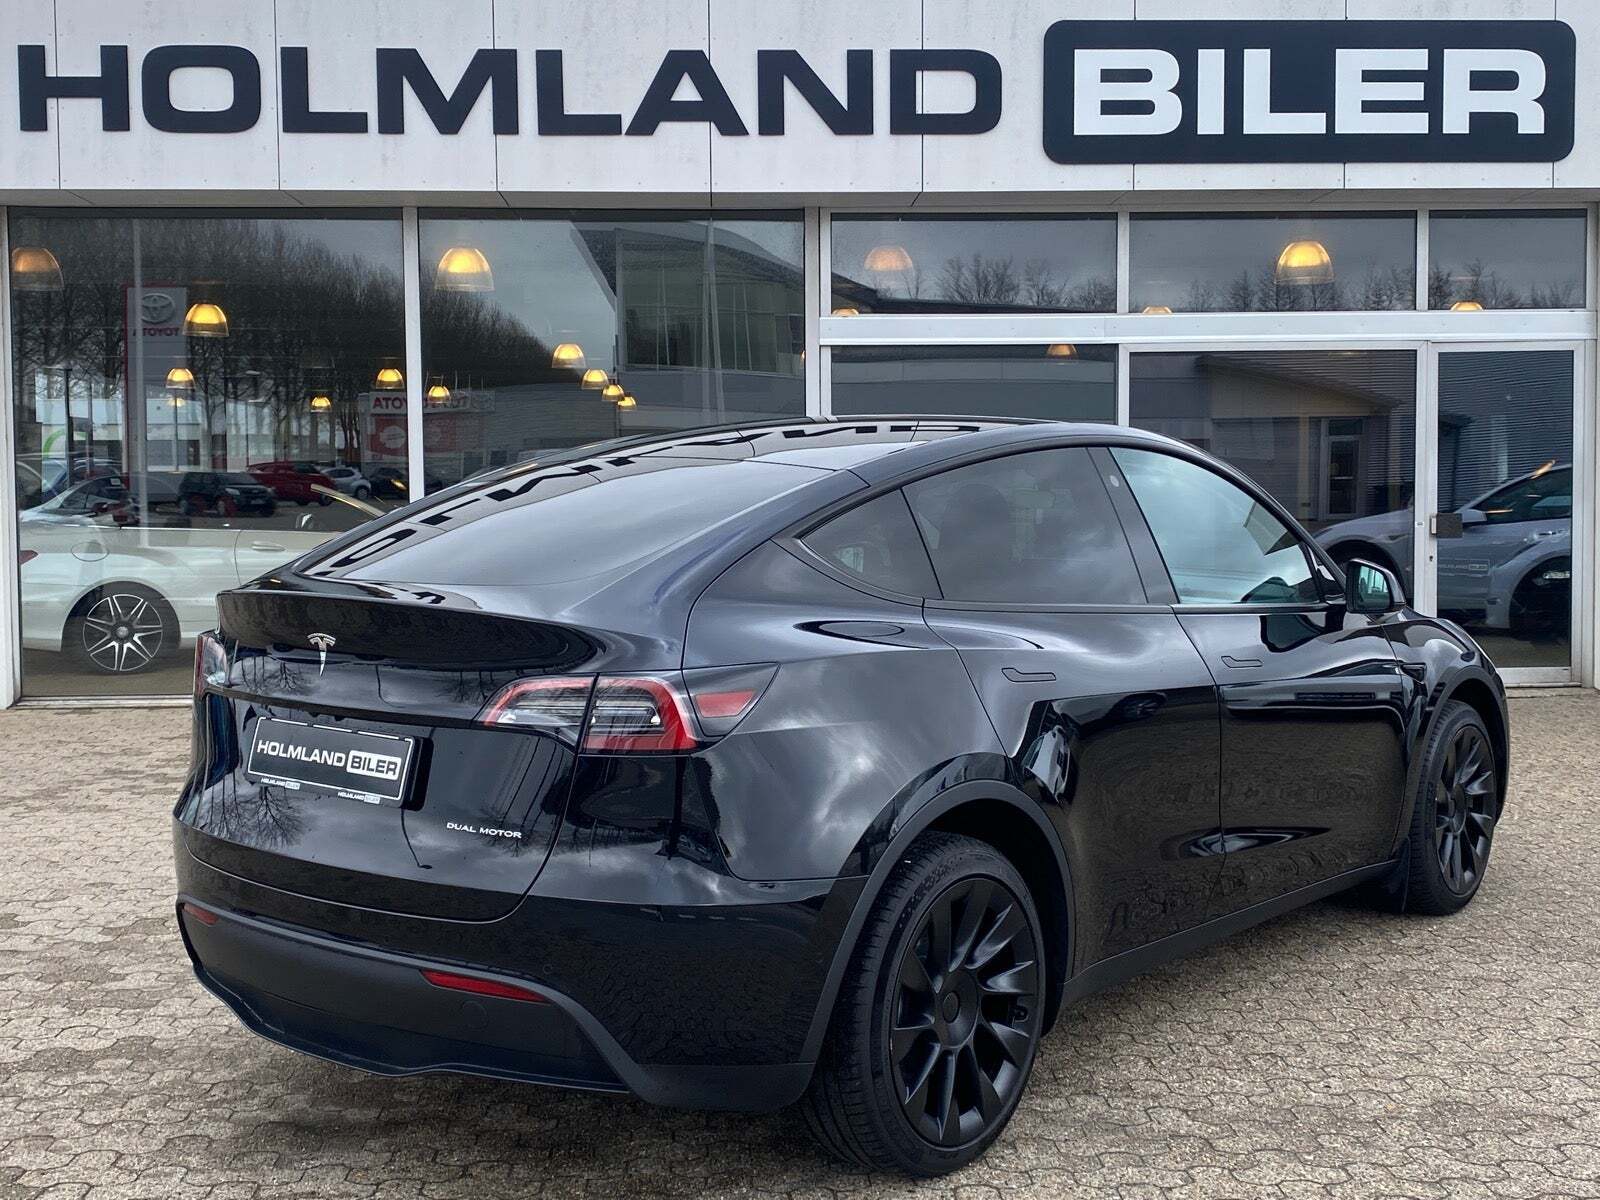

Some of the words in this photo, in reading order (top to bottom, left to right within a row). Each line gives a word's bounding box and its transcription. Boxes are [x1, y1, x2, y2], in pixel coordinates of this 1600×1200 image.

[18, 44, 1003, 136] HOLMLAND
[1073, 48, 1547, 135] BILER
[257, 740, 346, 767] HOLMLAND
[350, 755, 398, 776] BILER
[446, 822, 476, 832] DUAL
[480, 827, 522, 839] MOTOR
